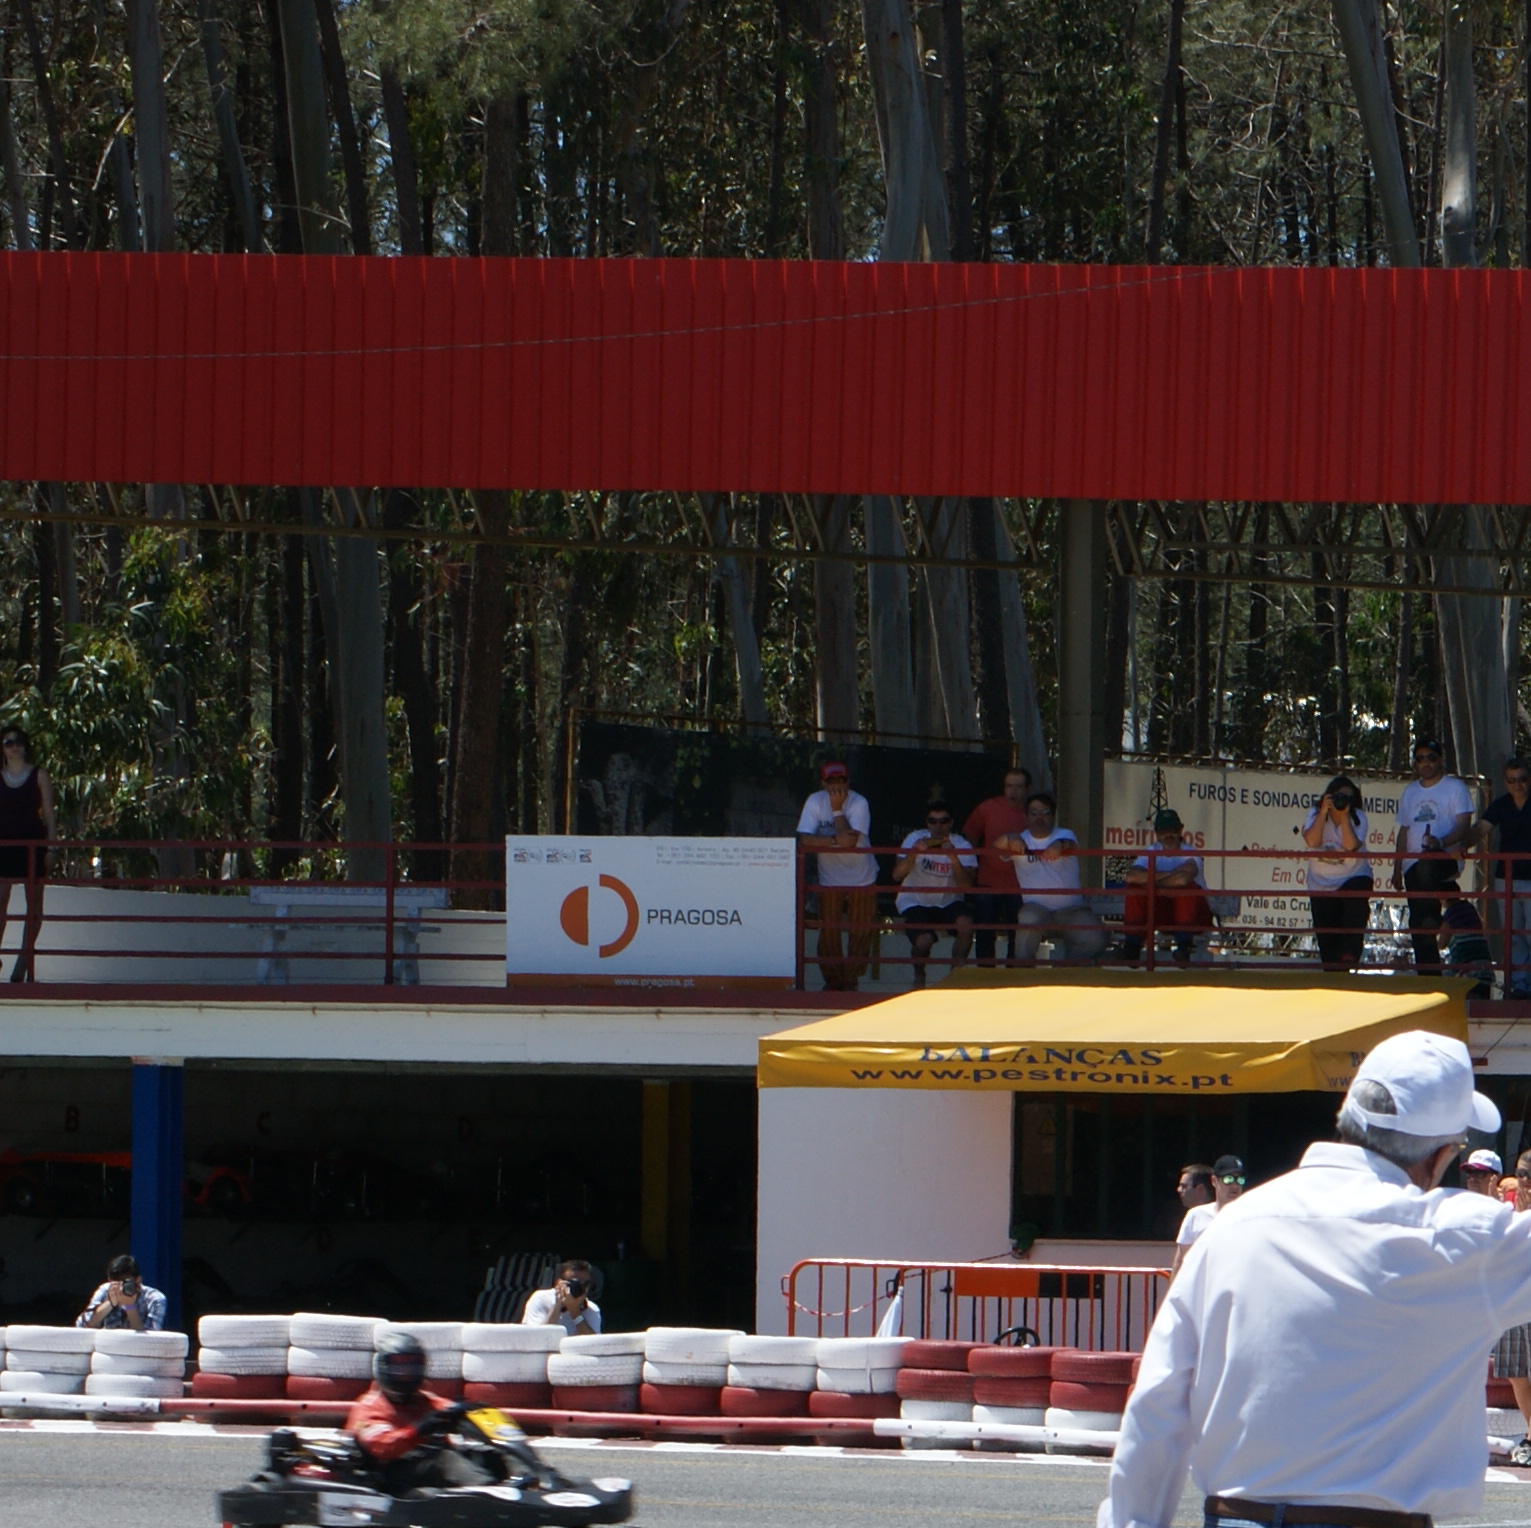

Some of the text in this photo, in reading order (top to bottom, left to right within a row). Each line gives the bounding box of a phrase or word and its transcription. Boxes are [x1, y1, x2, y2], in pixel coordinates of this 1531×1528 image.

[1189, 782, 1399, 814] FUROS E SONDAGE MEIRI
[1272, 867, 1292, 883] Em
[1246, 896, 1310, 912] Vale da Cru
[647, 909, 743, 925] PRAGOSA
[919, 1045, 1164, 1069] BALANÇAS
[850, 1066, 1234, 1090] www.pestronix.pt
[65, 1105, 81, 1132] B
